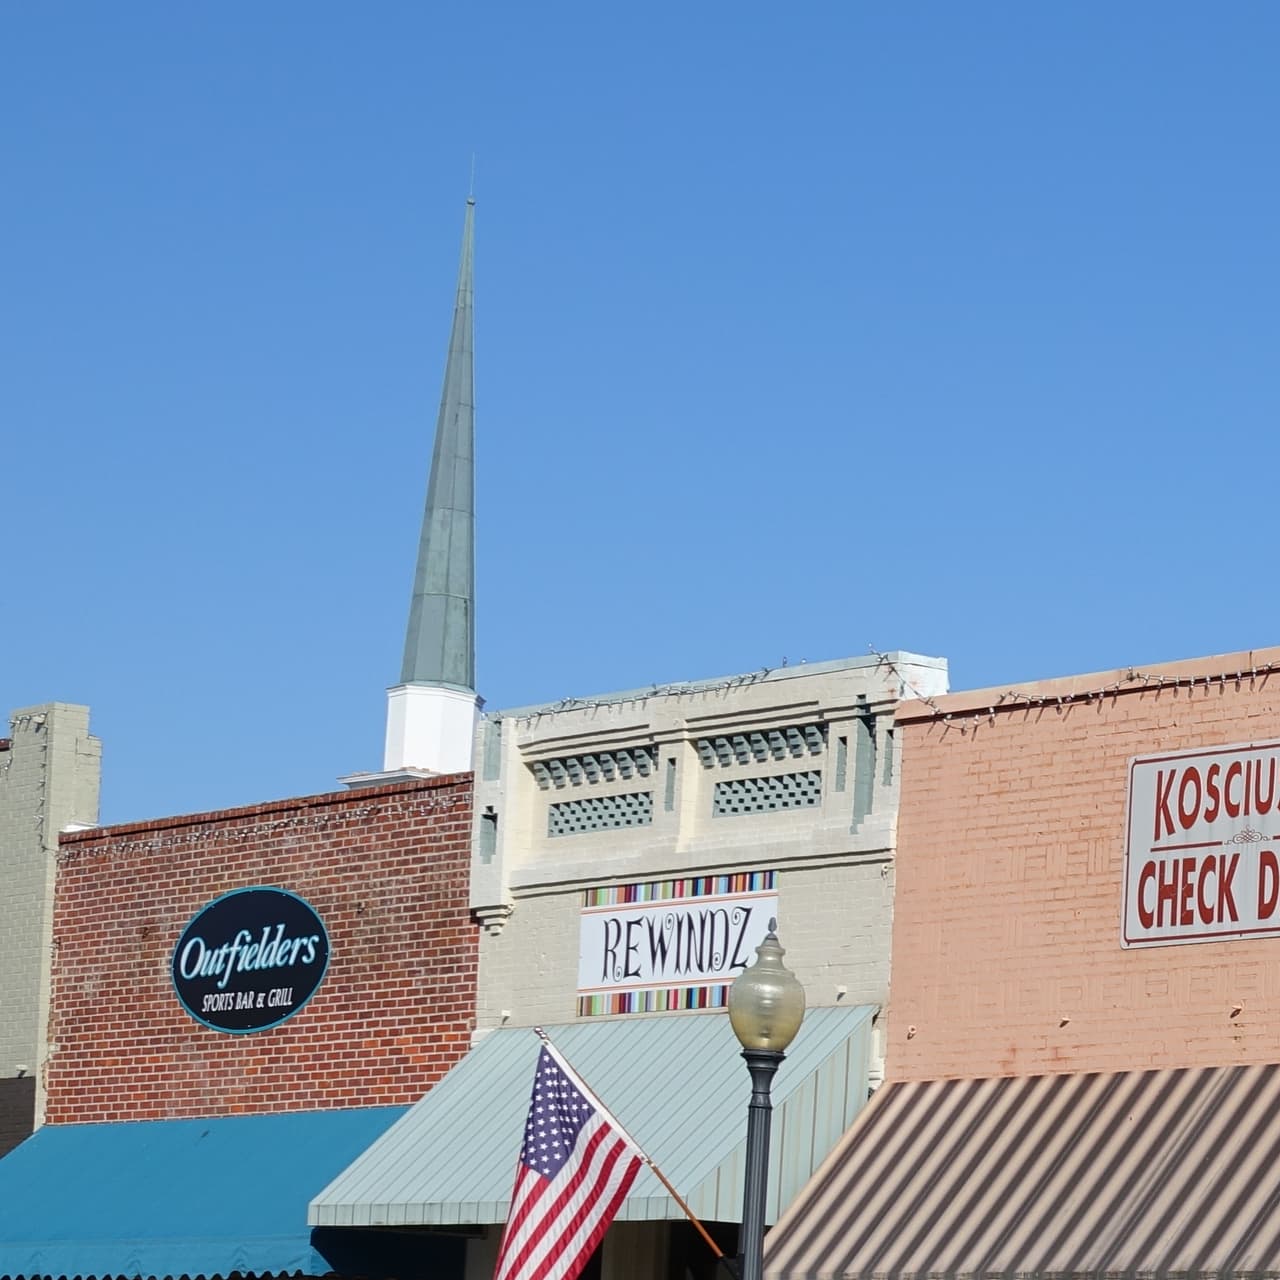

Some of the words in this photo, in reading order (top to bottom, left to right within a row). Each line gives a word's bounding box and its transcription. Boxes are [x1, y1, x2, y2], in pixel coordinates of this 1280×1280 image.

[1137, 852, 1241, 930] CHECK
[179, 923, 320, 990] Outfielders
[601, 906, 754, 984] REWINDZ
[201, 992, 236, 1013] SPORTS
[235, 990, 254, 1011] BAR
[256, 992, 266, 1009] &
[267, 987, 294, 1008] GRILL
